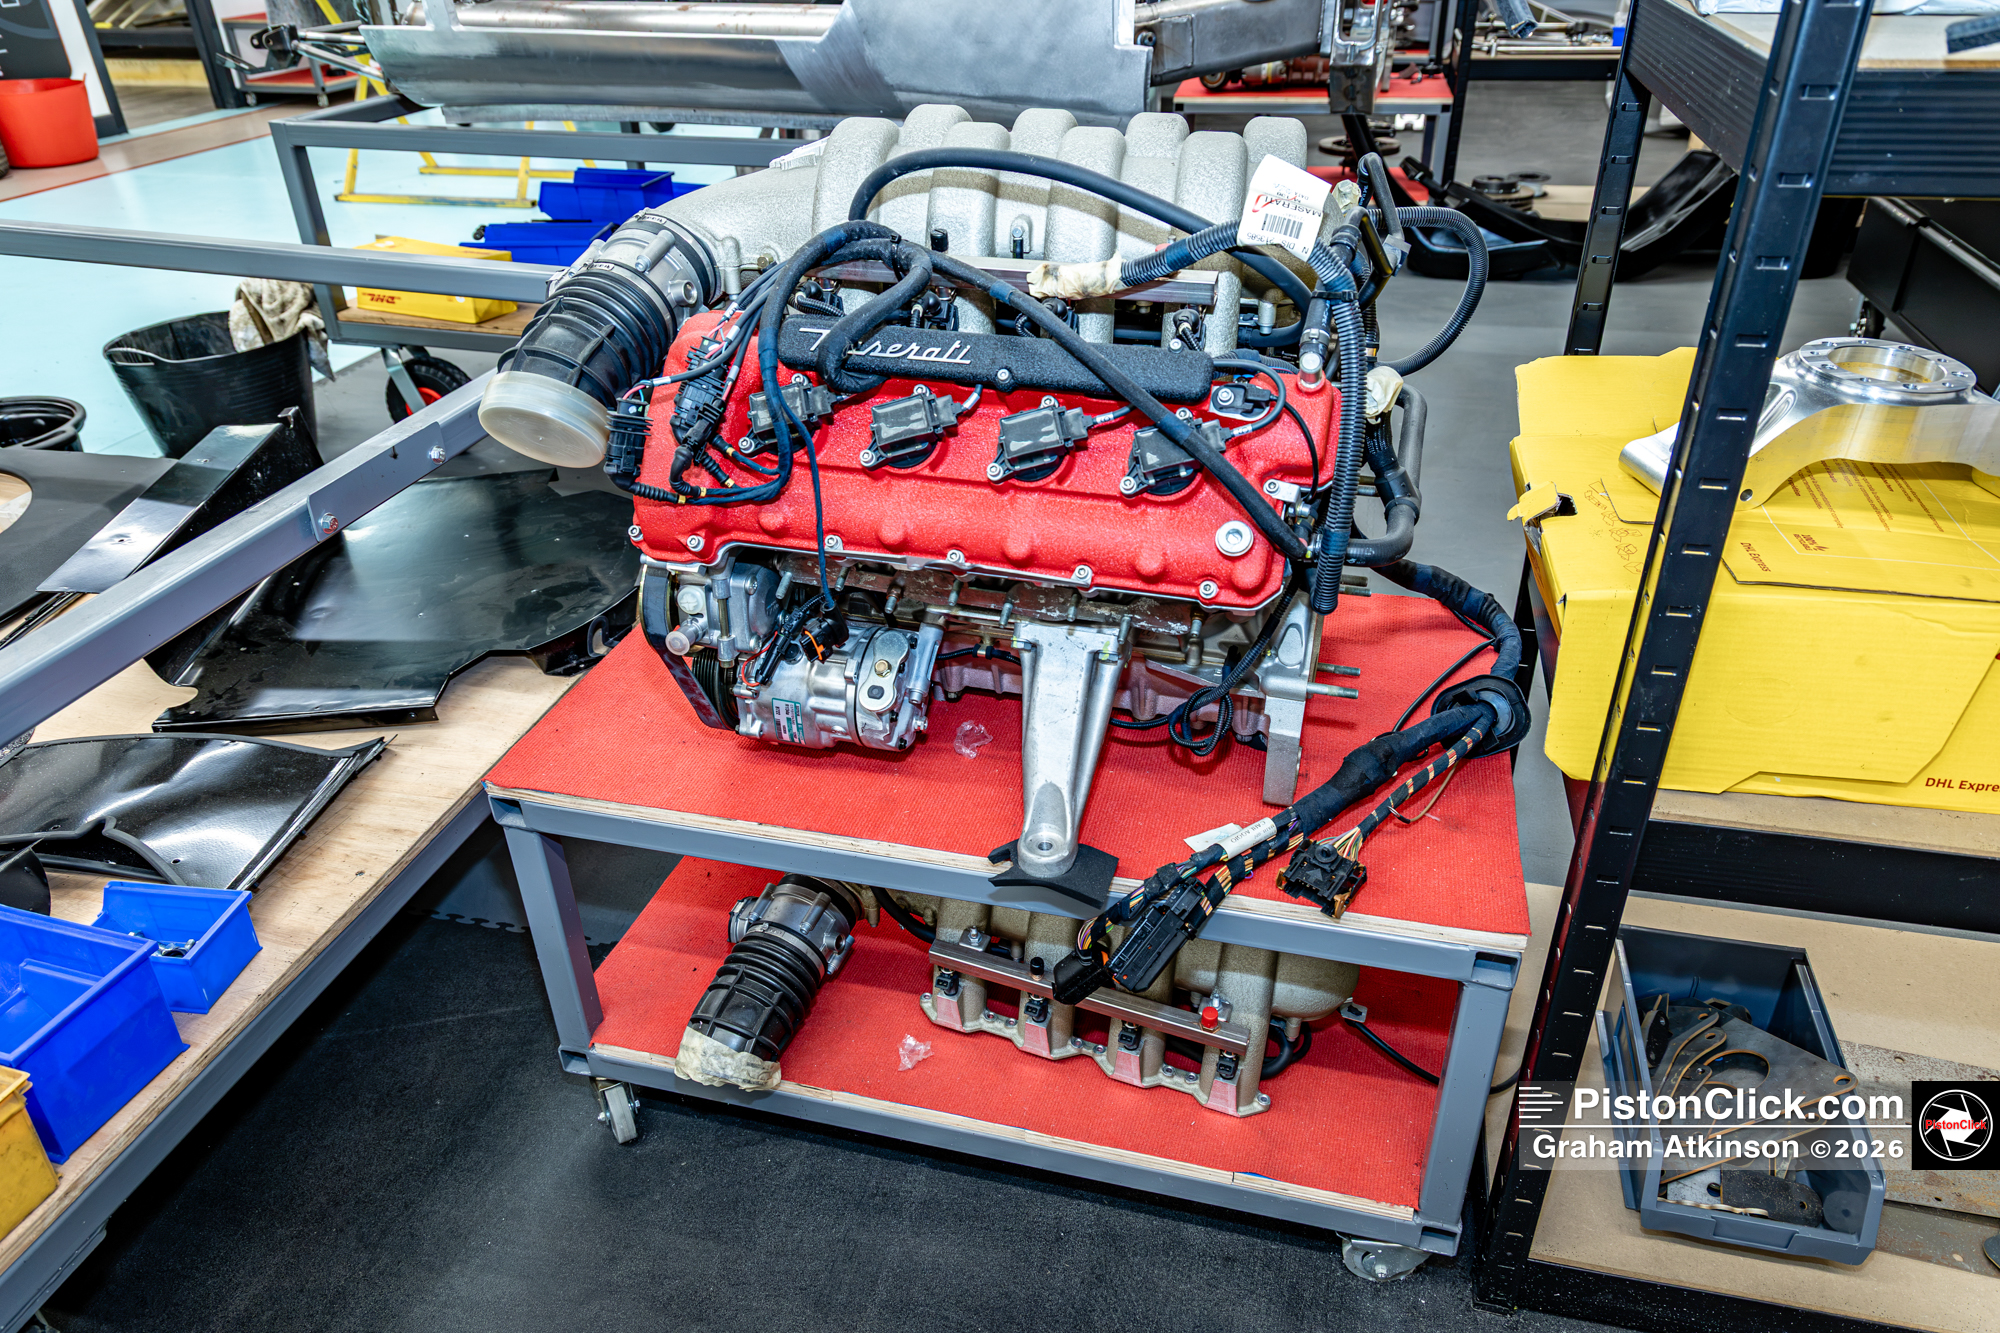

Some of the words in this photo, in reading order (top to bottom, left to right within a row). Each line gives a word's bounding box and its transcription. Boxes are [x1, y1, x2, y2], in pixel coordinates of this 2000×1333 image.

[1265, 195, 1323, 217] MASERATI
[1925, 777, 1955, 789] DHL
[1958, 780, 2000, 793] Expre
